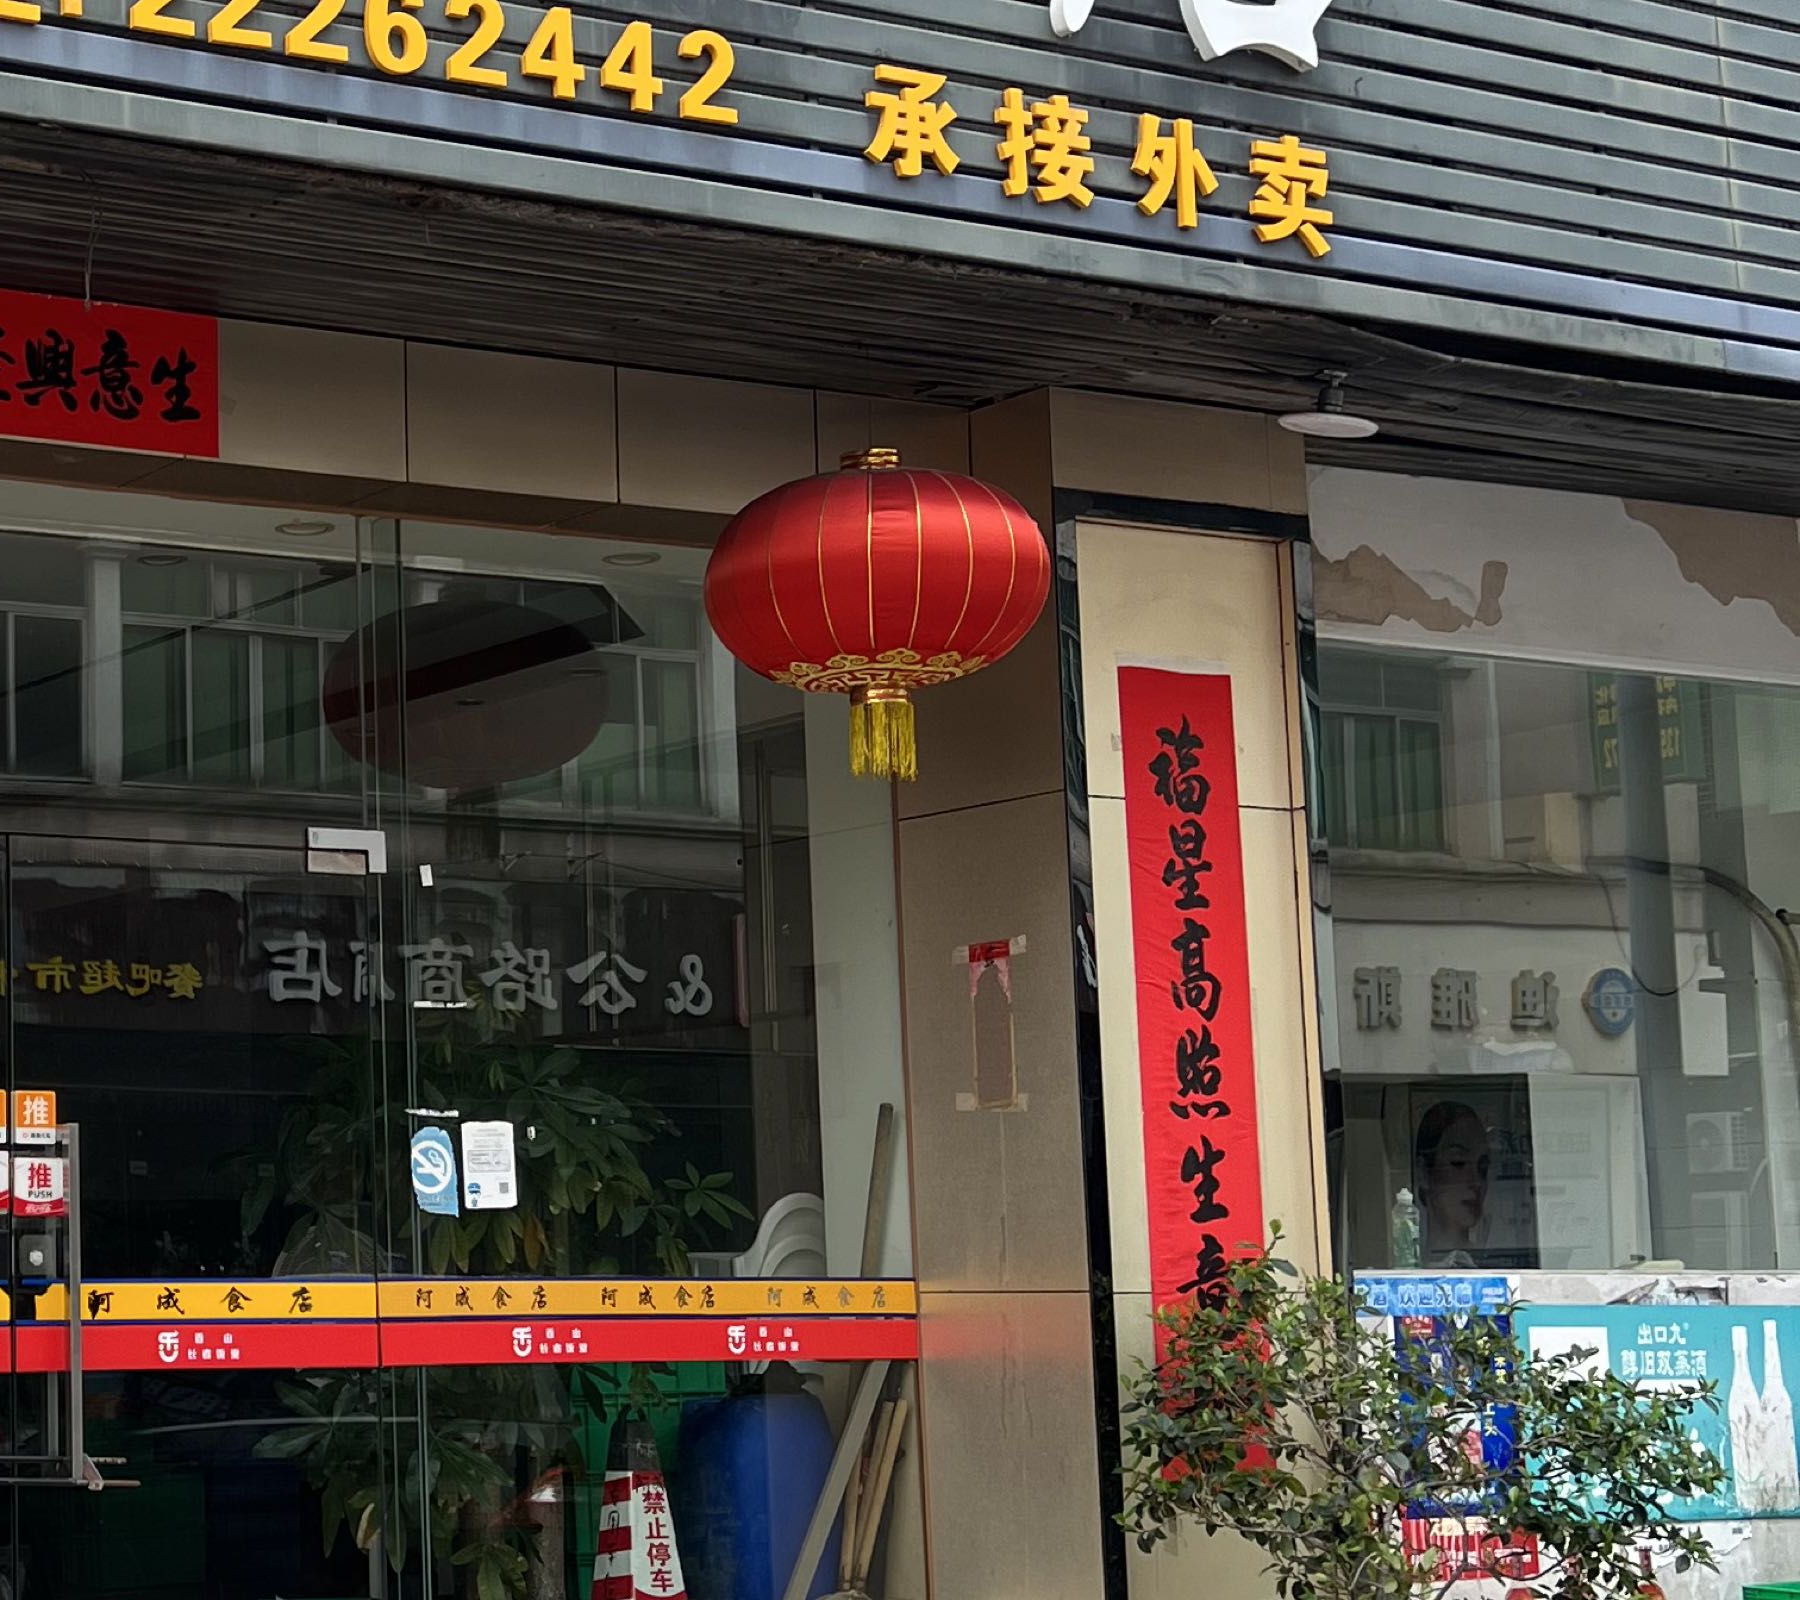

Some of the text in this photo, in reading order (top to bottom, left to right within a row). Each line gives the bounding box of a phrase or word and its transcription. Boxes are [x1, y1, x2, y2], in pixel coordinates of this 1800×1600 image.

[862, 64, 1336, 258] 承接外卖
[23, 1095, 49, 1125] 推
[28, 1163, 52, 1189] 推
[416, 1286, 547, 1310] 阿成食店
[642, 1491, 674, 1593] 禁止停车
